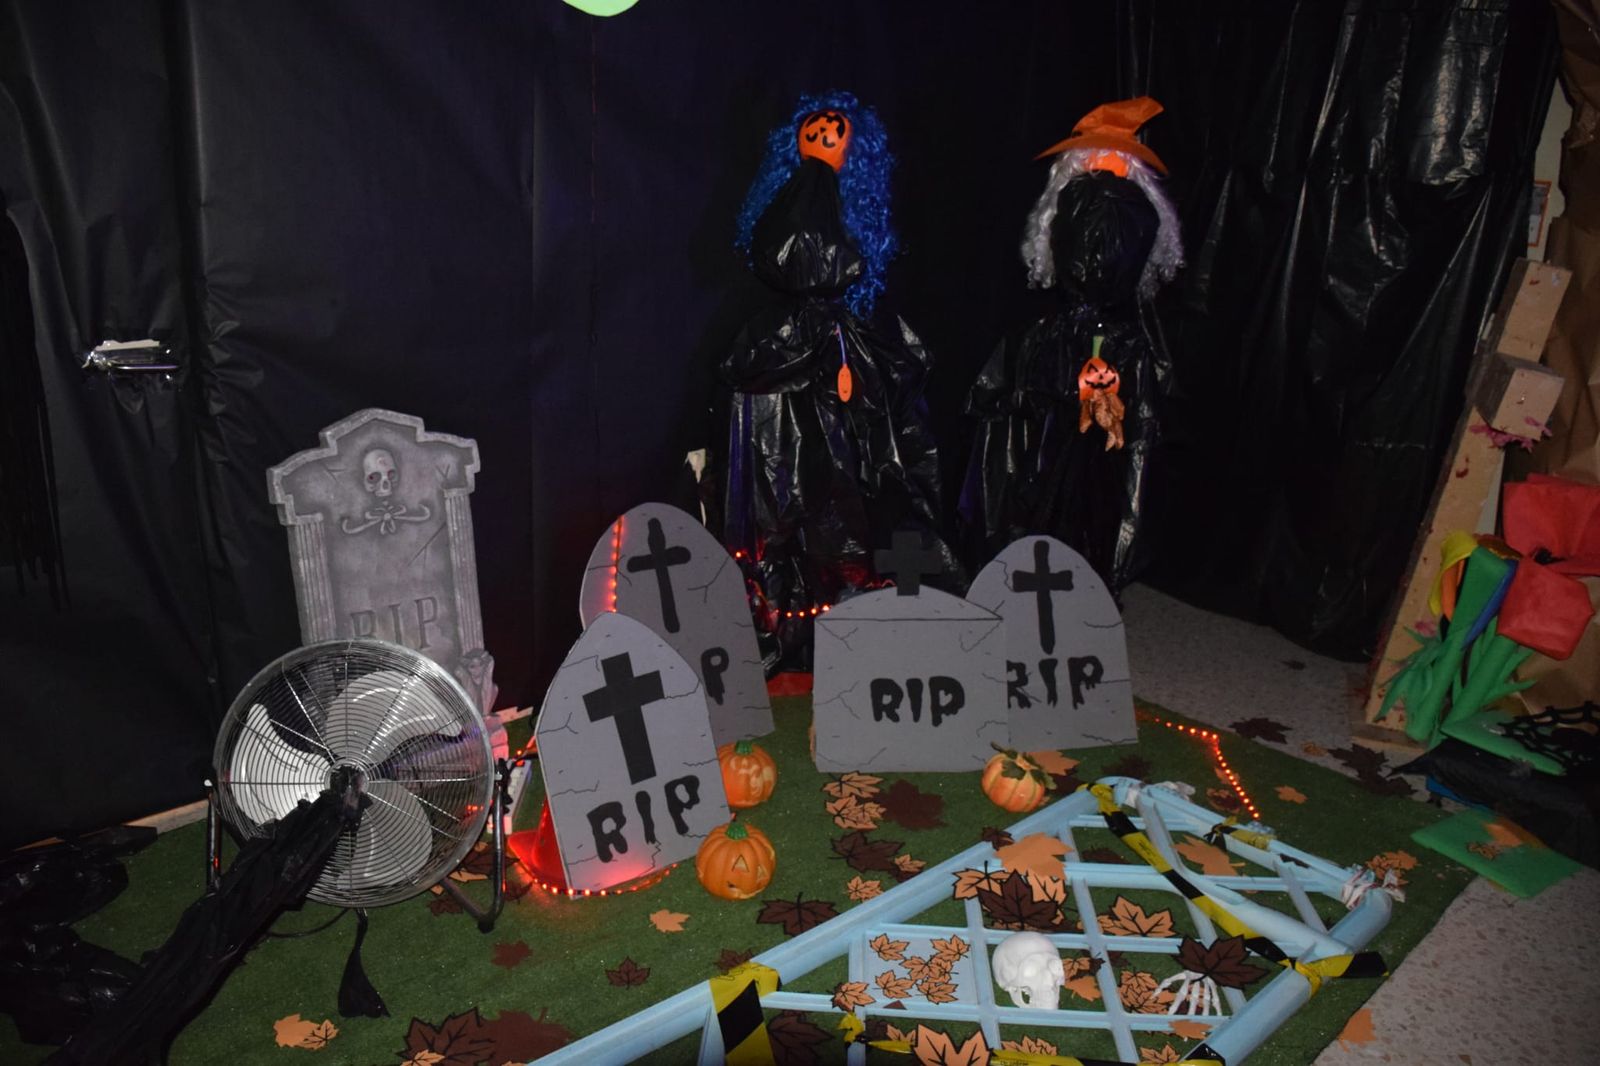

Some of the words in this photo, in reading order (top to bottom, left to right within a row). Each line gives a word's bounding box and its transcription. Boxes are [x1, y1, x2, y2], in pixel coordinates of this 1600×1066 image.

[870, 676, 965, 727] RIP
[1006, 655, 1104, 709] RIP
[587, 775, 700, 863] RIP
